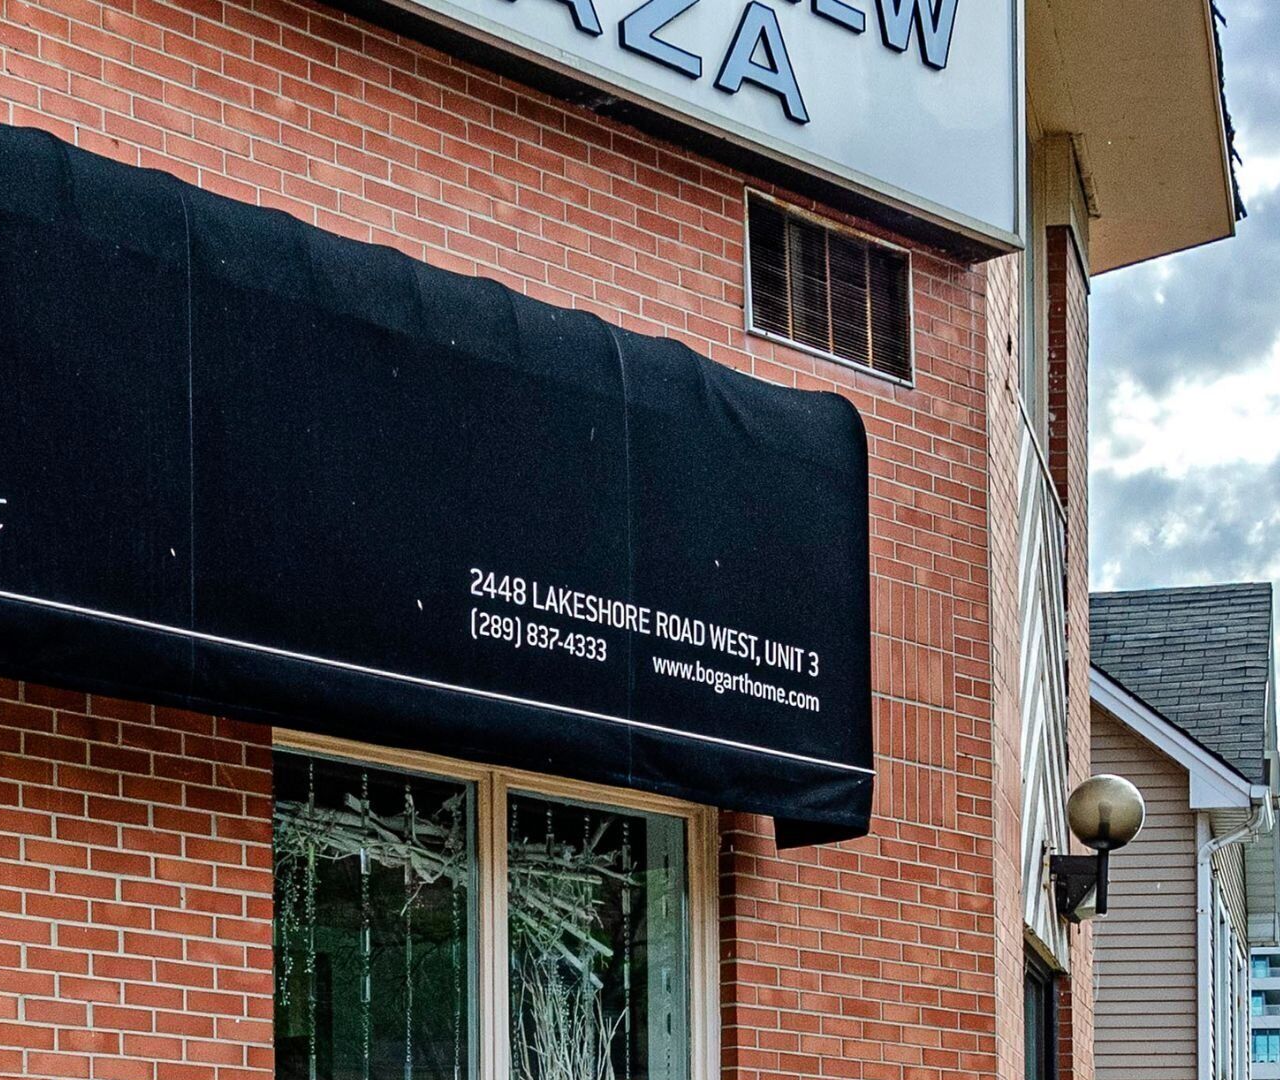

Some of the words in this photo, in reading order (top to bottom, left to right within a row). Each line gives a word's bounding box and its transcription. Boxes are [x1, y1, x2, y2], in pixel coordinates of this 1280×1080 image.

[469, 567, 527, 606] 2448
[532, 581, 651, 635] LAKESHORE
[655, 610, 706, 647] ROAD
[709, 623, 761, 667] WEST,
[764, 639, 805, 673] UNIT
[808, 651, 819, 677] 3
[470, 607, 522, 649] (289)
[526, 622, 607, 662] 837-4333
[652, 656, 820, 713] www.bogarthome.com
